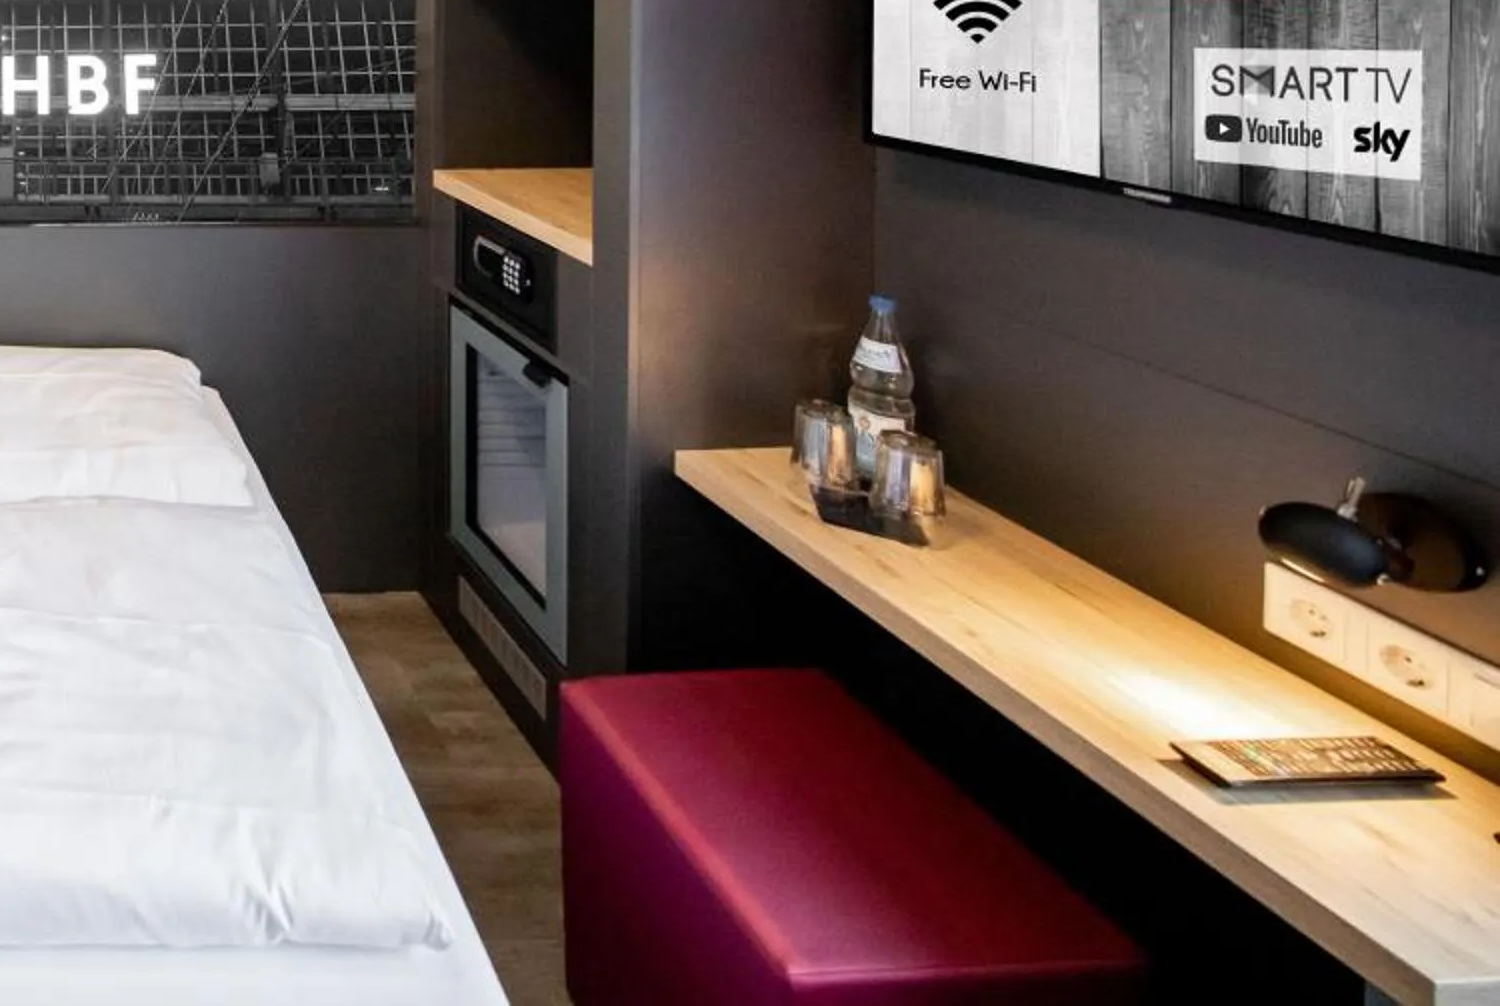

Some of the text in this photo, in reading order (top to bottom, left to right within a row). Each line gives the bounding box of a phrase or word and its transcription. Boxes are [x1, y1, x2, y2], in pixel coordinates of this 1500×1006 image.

[1, 53, 158, 116] HBF
[918, 67, 1037, 93] Free Wi-Fi
[1211, 62, 1413, 104] SMART TV
[1245, 116, 1324, 149] YouTube
[1352, 120, 1412, 163] sky
